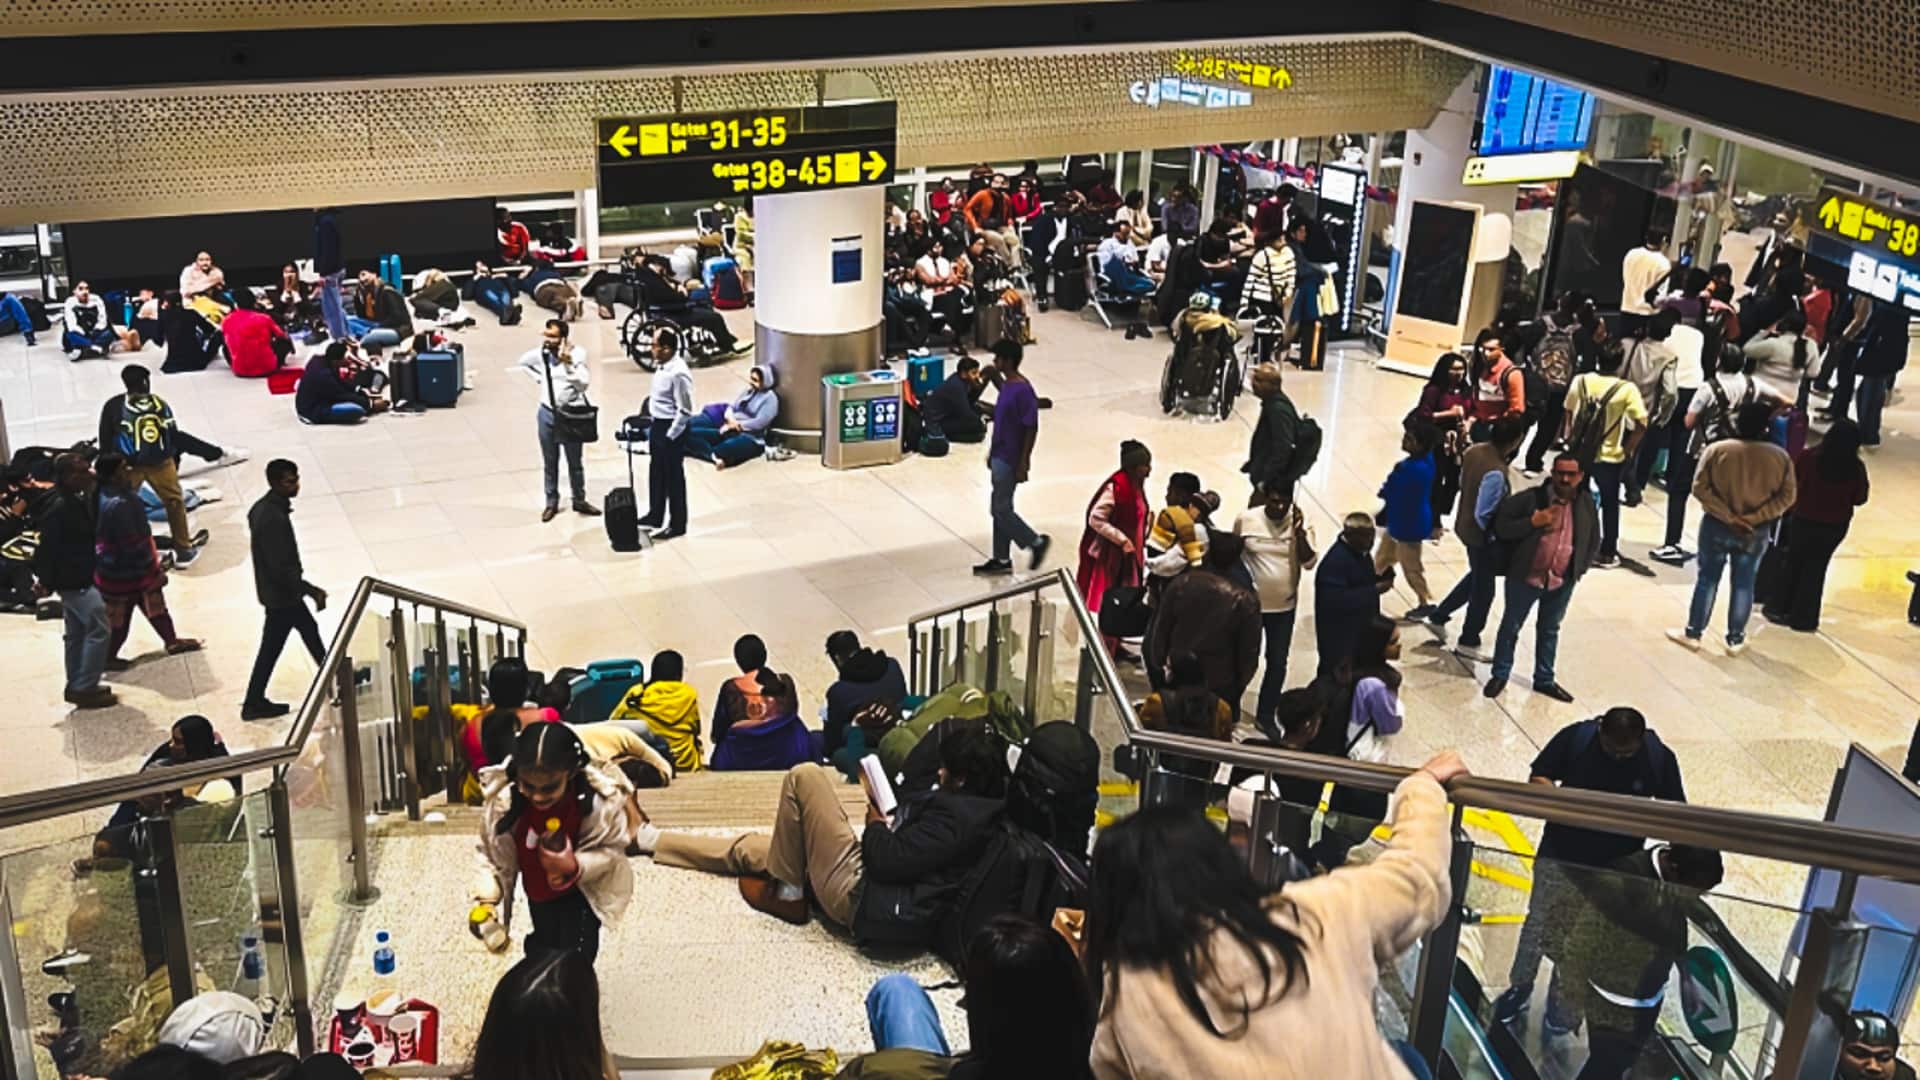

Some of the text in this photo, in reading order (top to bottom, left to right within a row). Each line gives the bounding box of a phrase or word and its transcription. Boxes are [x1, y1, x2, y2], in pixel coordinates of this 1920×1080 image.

[710, 116, 786, 149] 31-35
[751, 155, 832, 190] 38-45
[1888, 218, 1919, 256] 38
